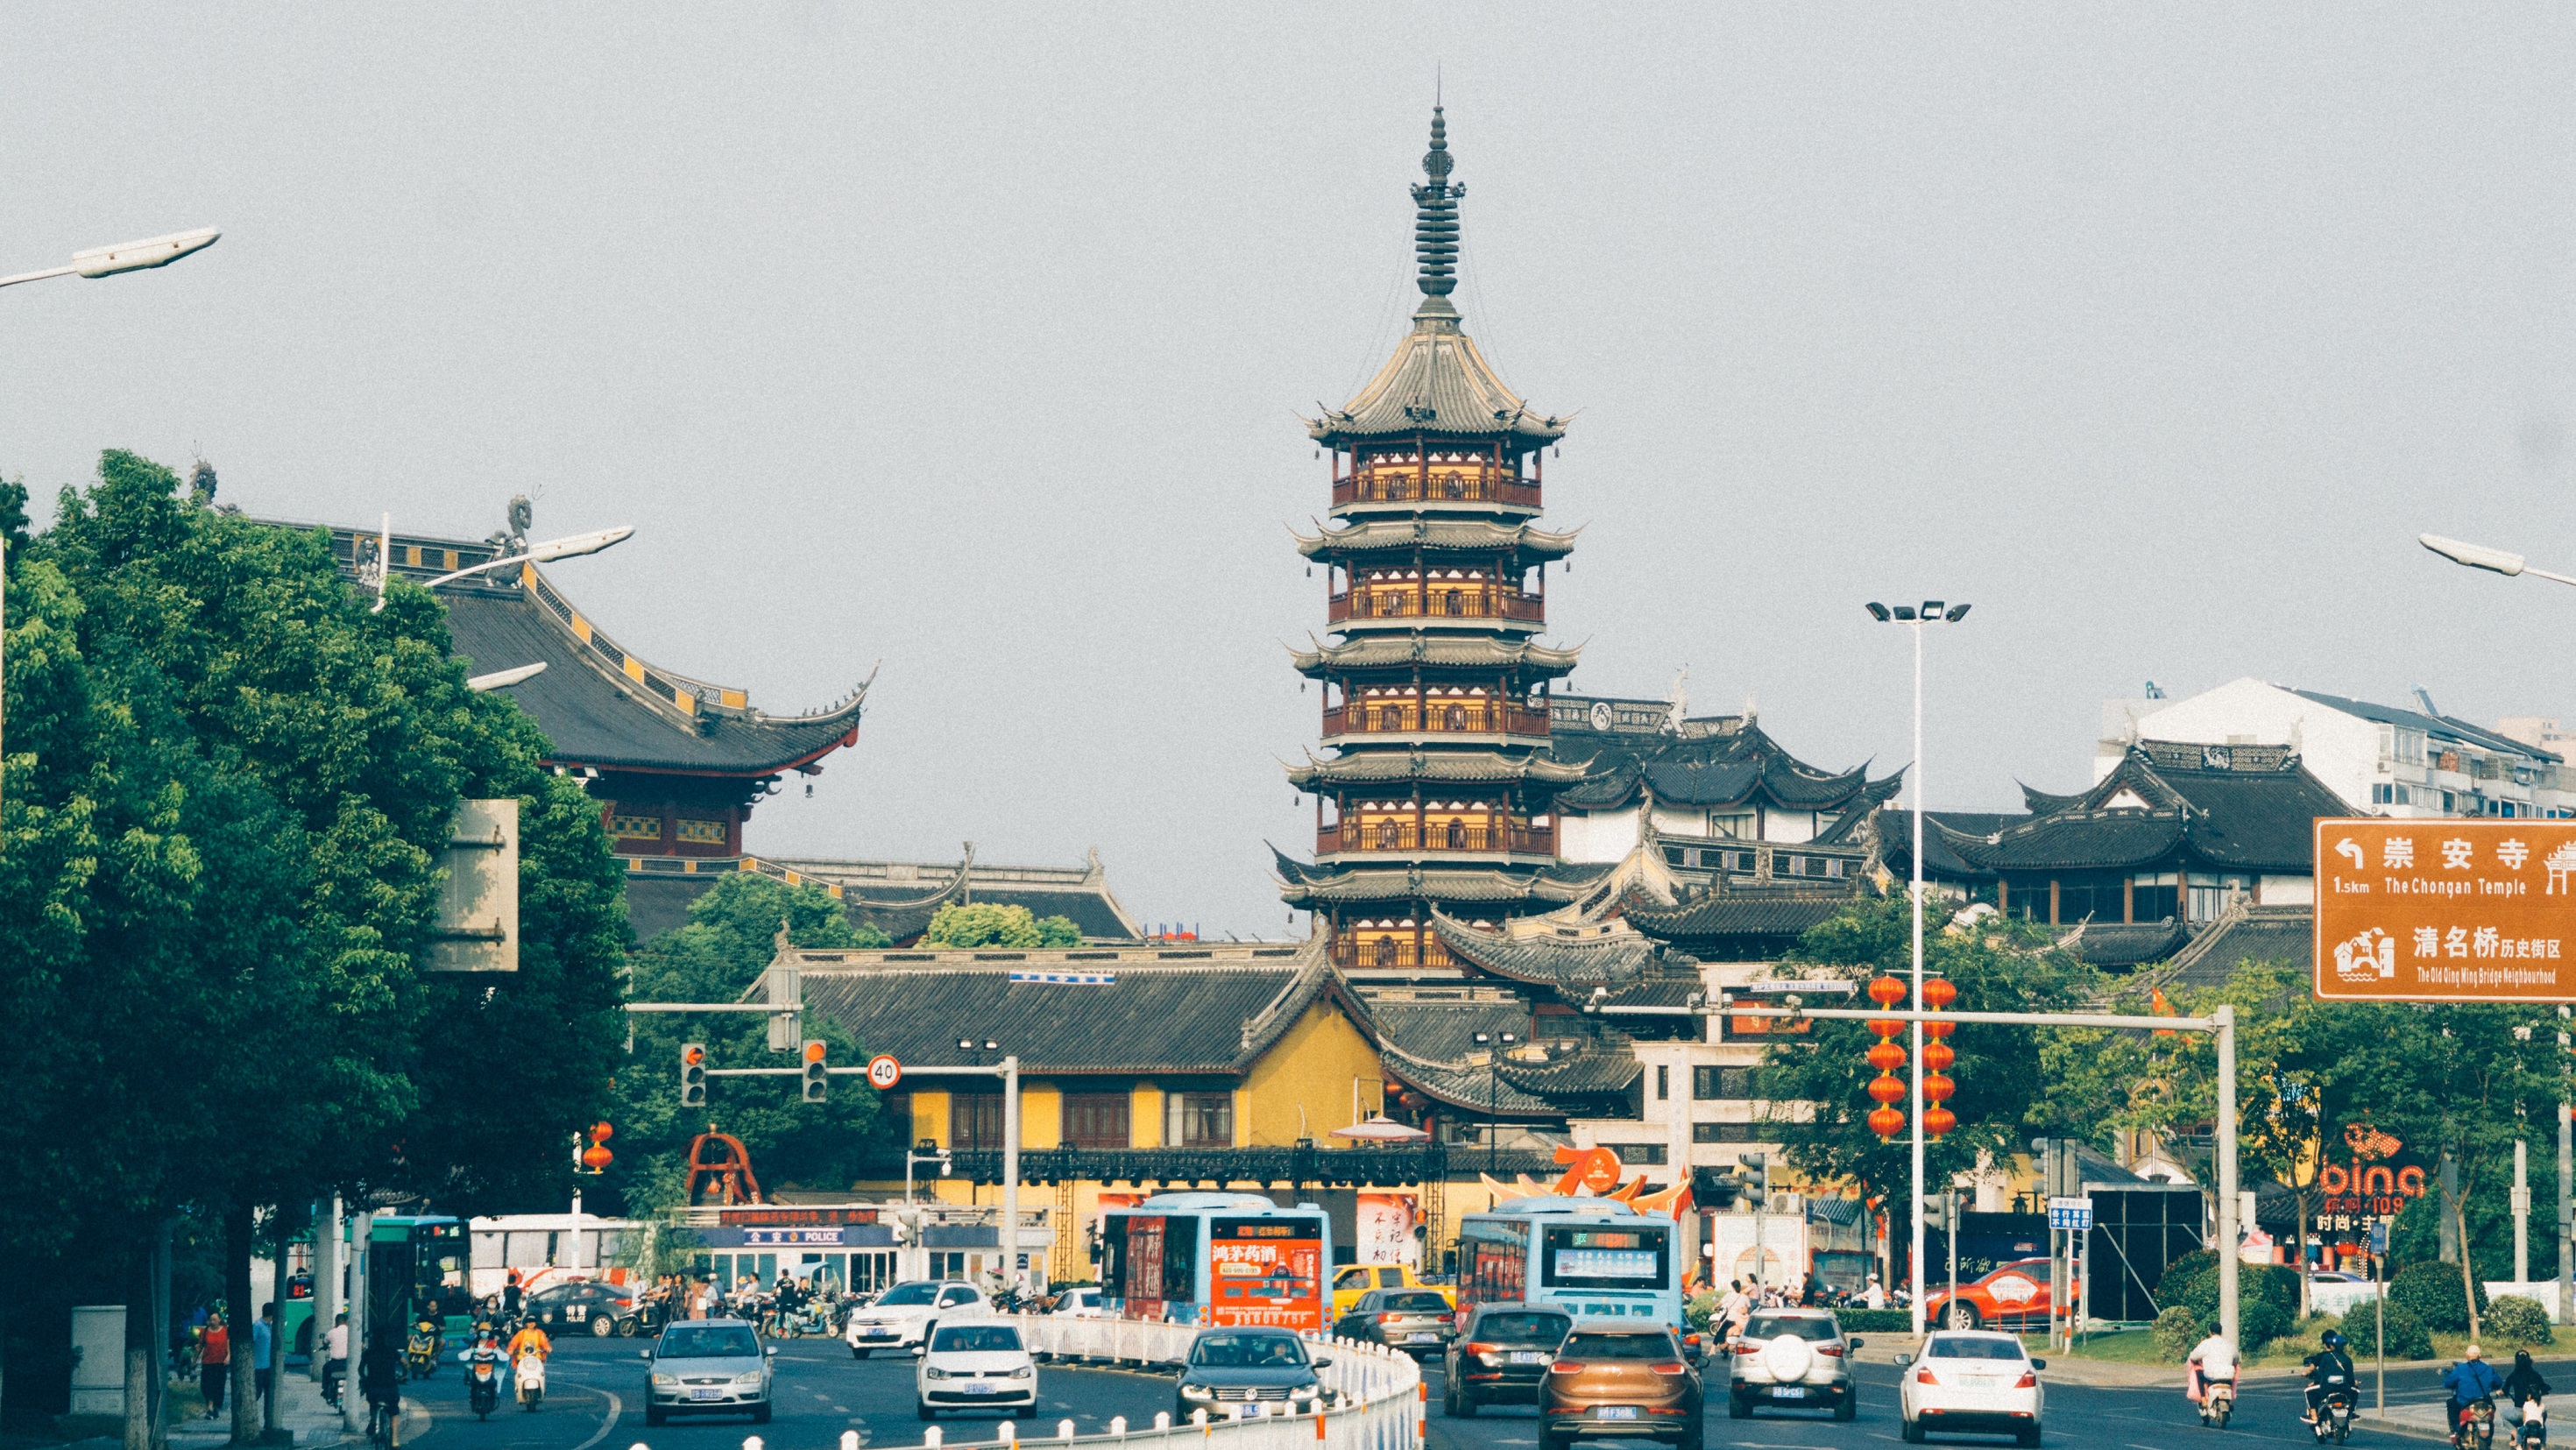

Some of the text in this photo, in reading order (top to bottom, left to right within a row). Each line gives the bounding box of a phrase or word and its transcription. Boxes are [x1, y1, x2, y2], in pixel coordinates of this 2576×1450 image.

[2383, 837, 2530, 870] 崇安寺
[2333, 876, 2369, 894] 1.5km
[2385, 877, 2526, 898] The Chongan Temple
[2417, 966, 2556, 988] The Old Qing Ming Bridge Neighbourhood
[875, 1065, 893, 1079] 40
[751, 1232, 782, 1242] 公安
[805, 1232, 839, 1241] POLICE
[1213, 1245, 1277, 1262] 鸿茅药酒
